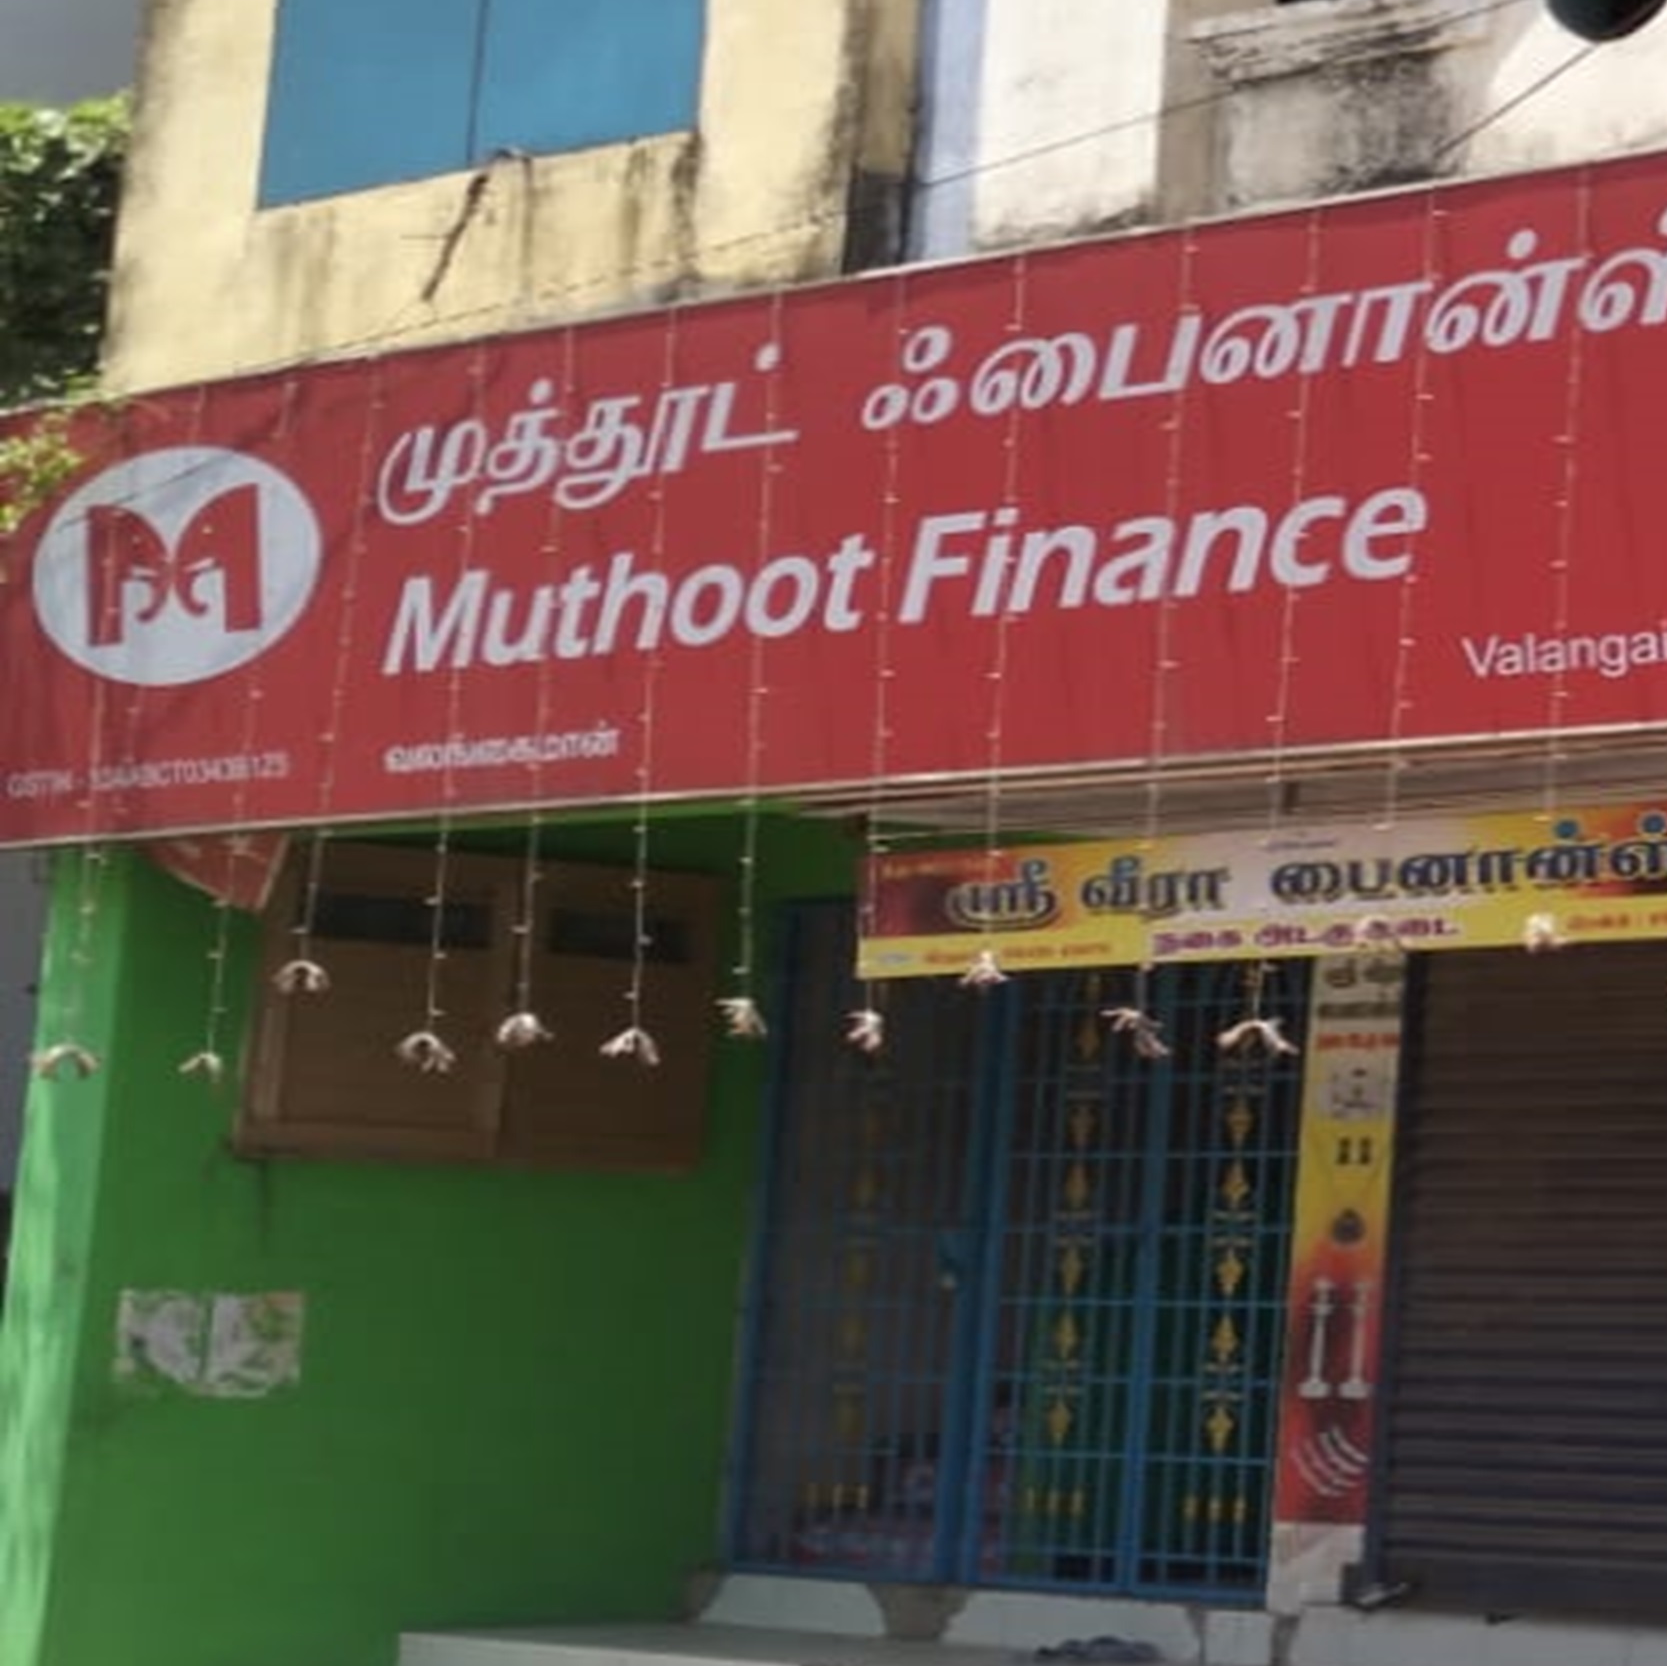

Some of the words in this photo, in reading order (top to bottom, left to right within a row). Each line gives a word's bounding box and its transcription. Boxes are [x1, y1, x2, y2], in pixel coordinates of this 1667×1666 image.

[377, 341, 801, 525] முத்தூட்
[382, 532, 875, 675] Muthoot
[897, 485, 1427, 624] Finance
[1080, 854, 1233, 918] வீரா
